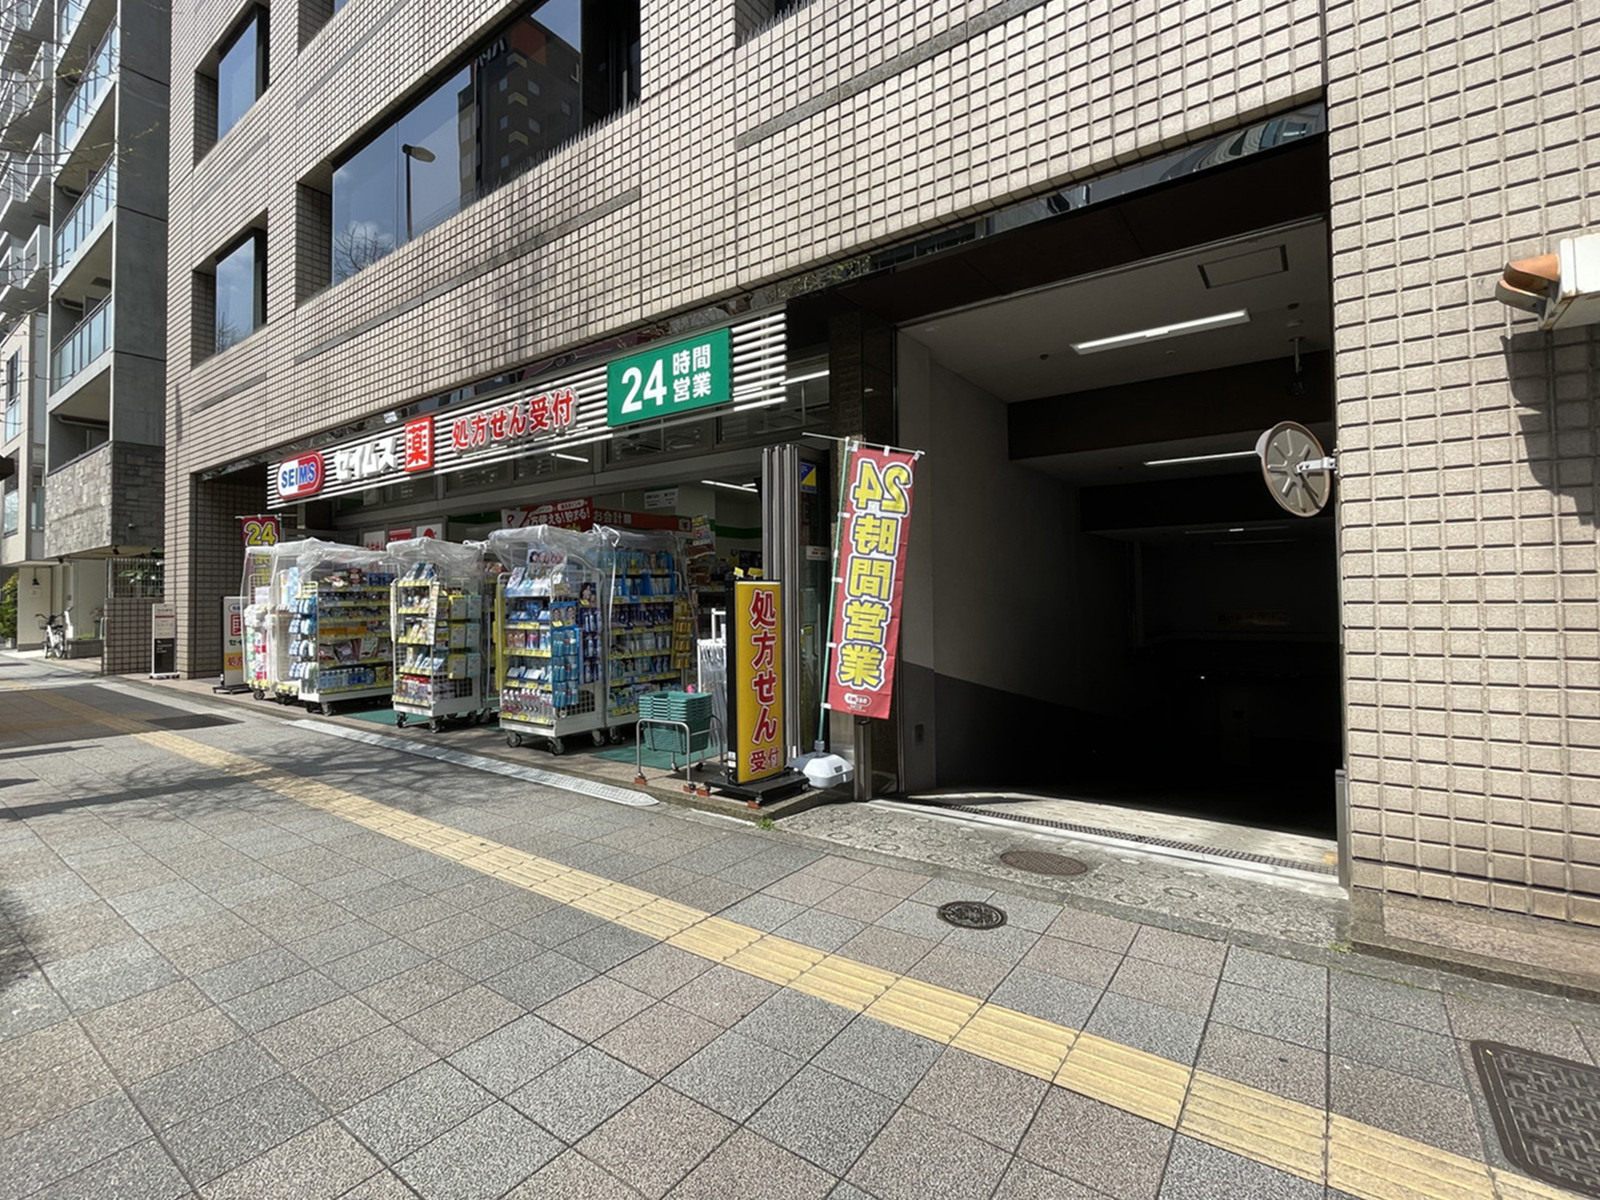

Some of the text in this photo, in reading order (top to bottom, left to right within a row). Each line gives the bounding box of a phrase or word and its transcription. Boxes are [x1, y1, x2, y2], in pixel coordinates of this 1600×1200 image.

[672, 343, 712, 376] 時間
[620, 358, 668, 414] 24
[672, 371, 712, 403] 営業
[450, 387, 577, 451] 処方せん受付
[334, 424, 428, 482] セイムス 薬
[281, 461, 317, 488] SEIMS
[245, 522, 277, 546] 24
[749, 589, 779, 744] 処方せん
[750, 747, 780, 774] 受付
